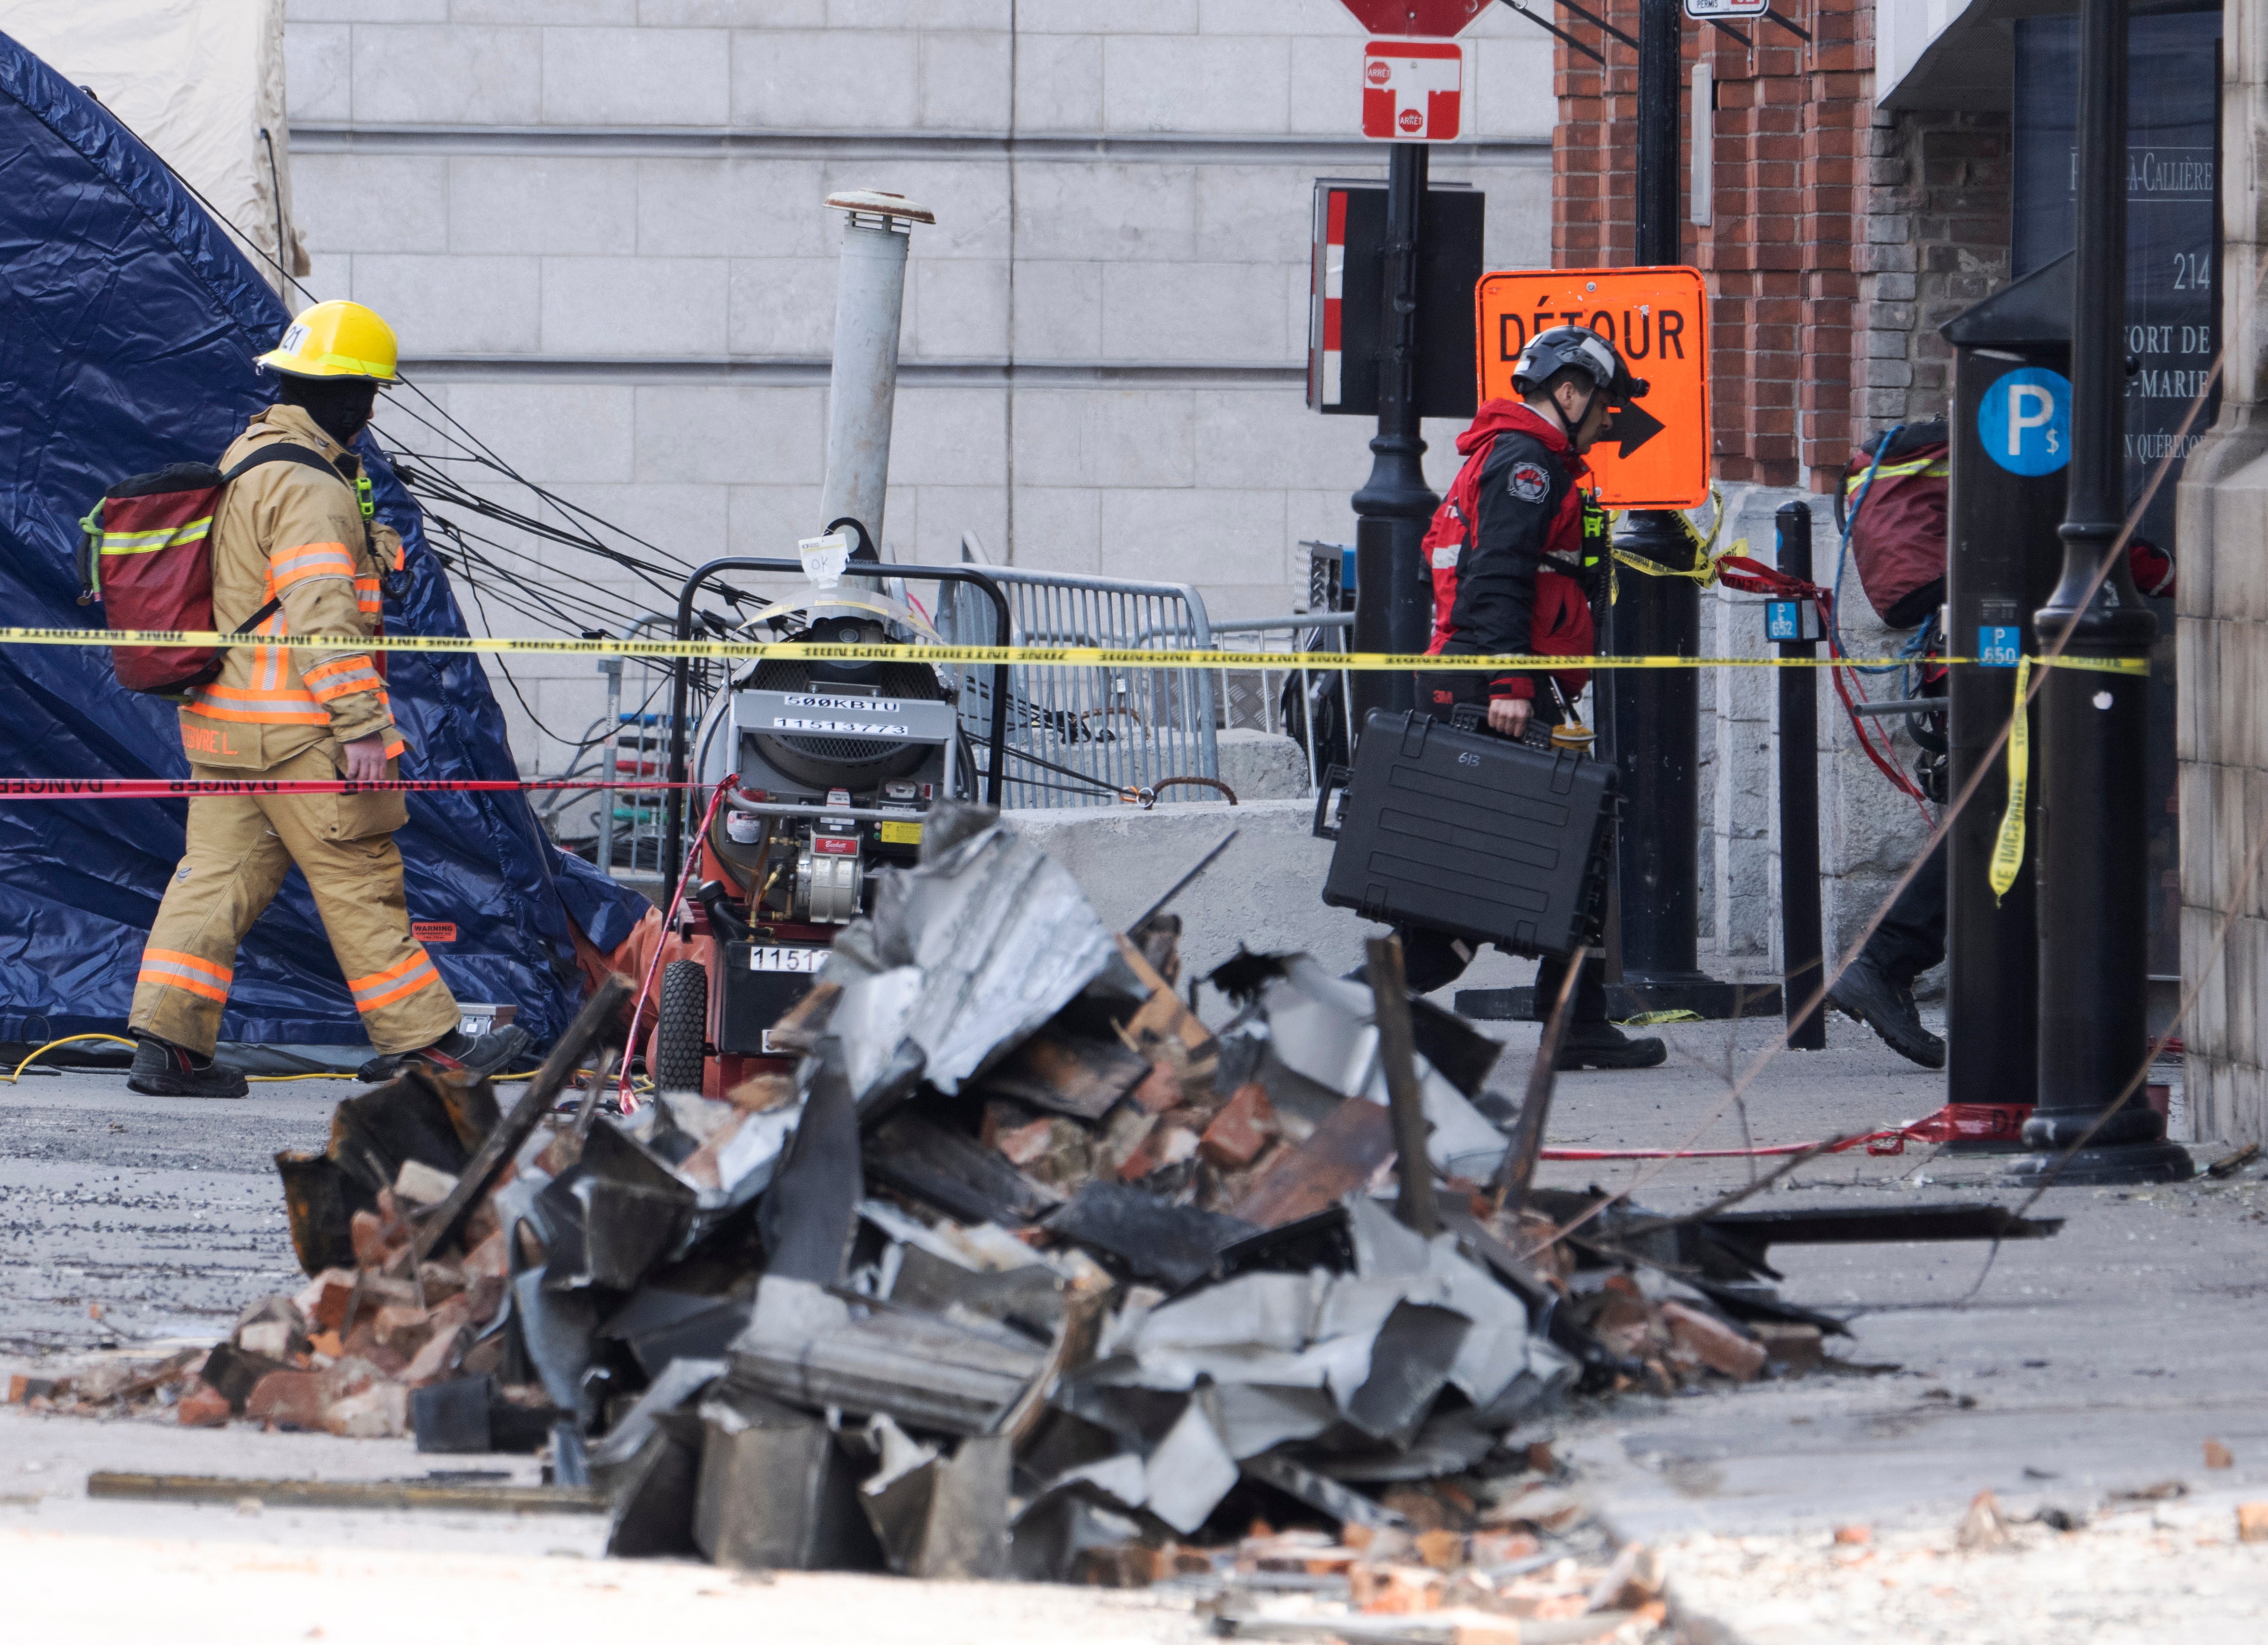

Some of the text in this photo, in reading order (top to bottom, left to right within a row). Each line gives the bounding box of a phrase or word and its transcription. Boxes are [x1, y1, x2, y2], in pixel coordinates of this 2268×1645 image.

[1697, 0, 1718, 8] PERMIS
[2174, 253, 2210, 290] 214
[282, 326, 303, 352] 21
[2124, 326, 2210, 354] ORT DE
[2124, 370, 2210, 397] -MARIE
[2008, 384, 2054, 456] P
[812, 555, 828, 572] OK
[1772, 620, 1792, 636] 652
[1994, 628, 2006, 645] P
[1984, 646, 2016, 664] 650
[1433, 690, 1453, 704] 3M
[777, 718, 905, 734] 11513773
